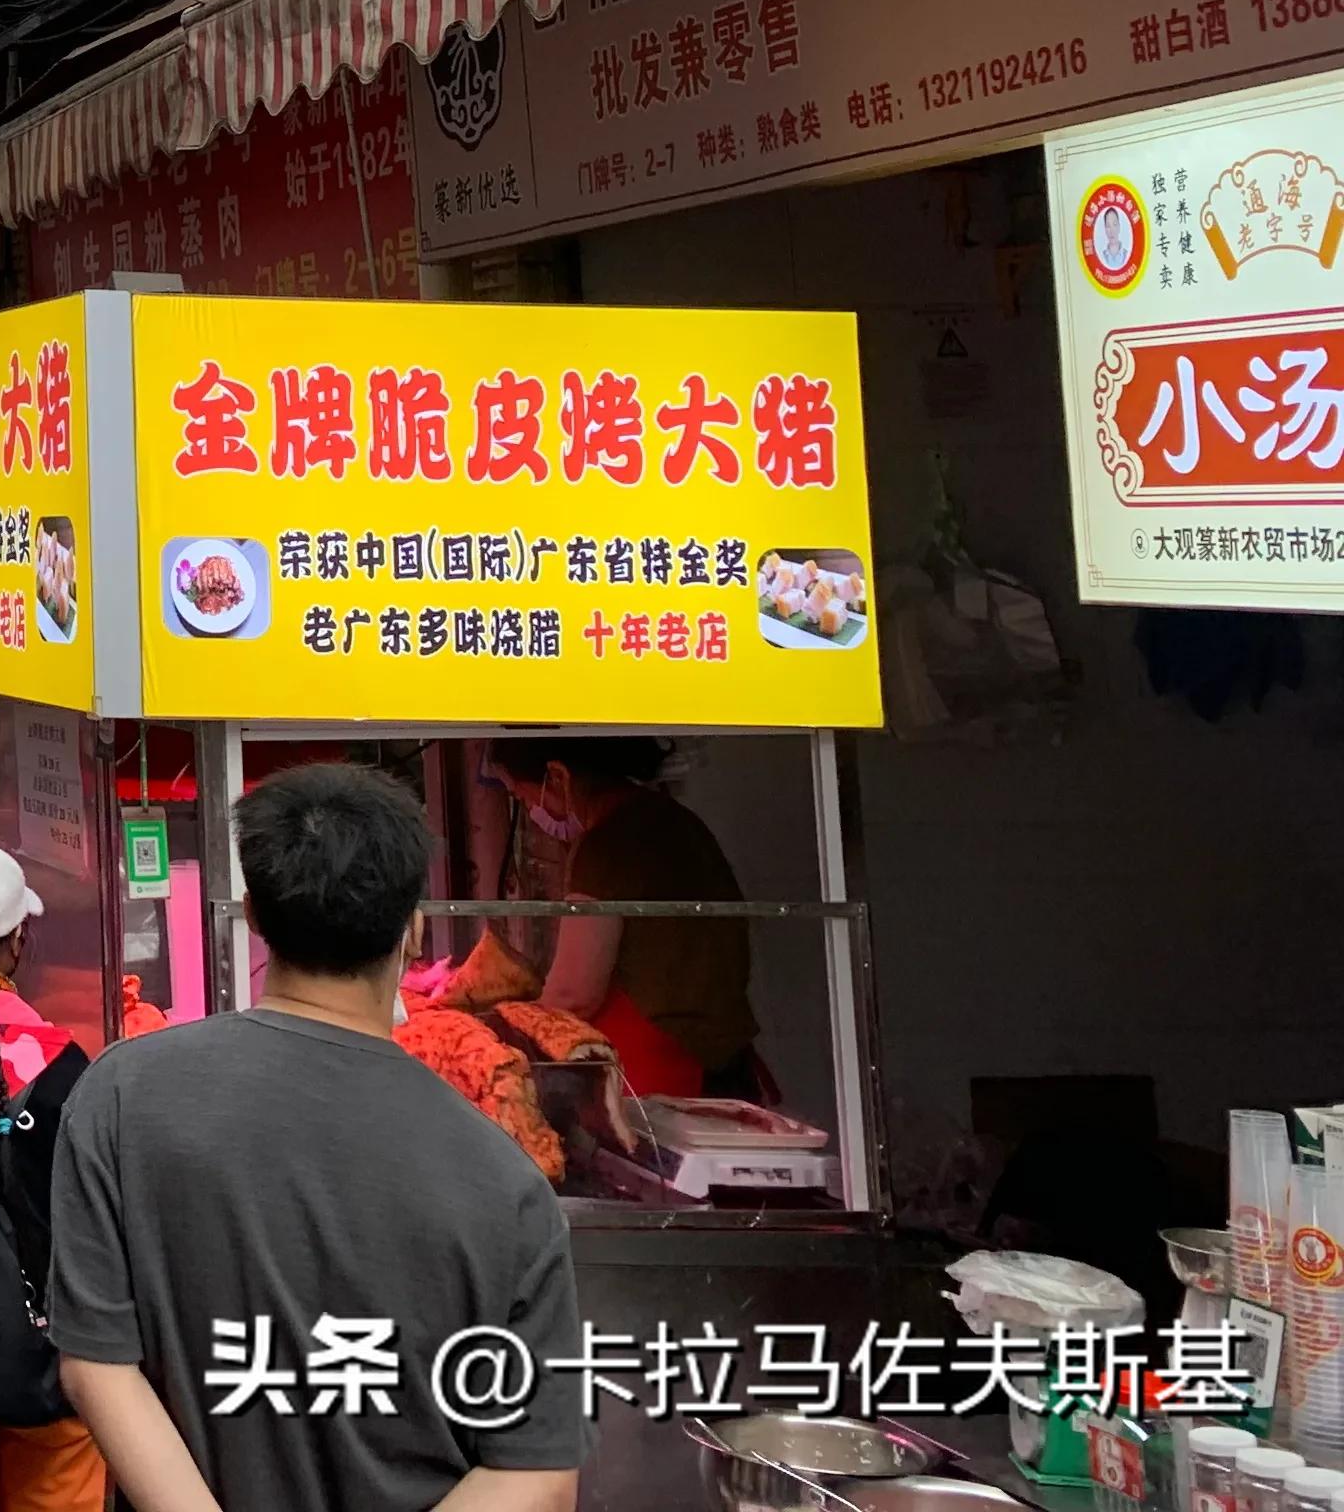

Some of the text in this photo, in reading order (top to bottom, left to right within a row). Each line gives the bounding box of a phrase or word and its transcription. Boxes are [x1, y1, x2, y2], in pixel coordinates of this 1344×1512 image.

[1151, 172, 1174, 291] 独家专卖
[1173, 168, 1199, 289] 营养健康
[1237, 211, 1316, 252] 老字号
[1240, 172, 1304, 221] 通海
[169, 358, 840, 491] 金牌脆皮烤大猪
[1137, 345, 1344, 475] 小汤
[277, 524, 750, 589] 荣获中国(国际)广东省特金奖
[301, 606, 730, 663] 老广东多味烧腊 十年老店
